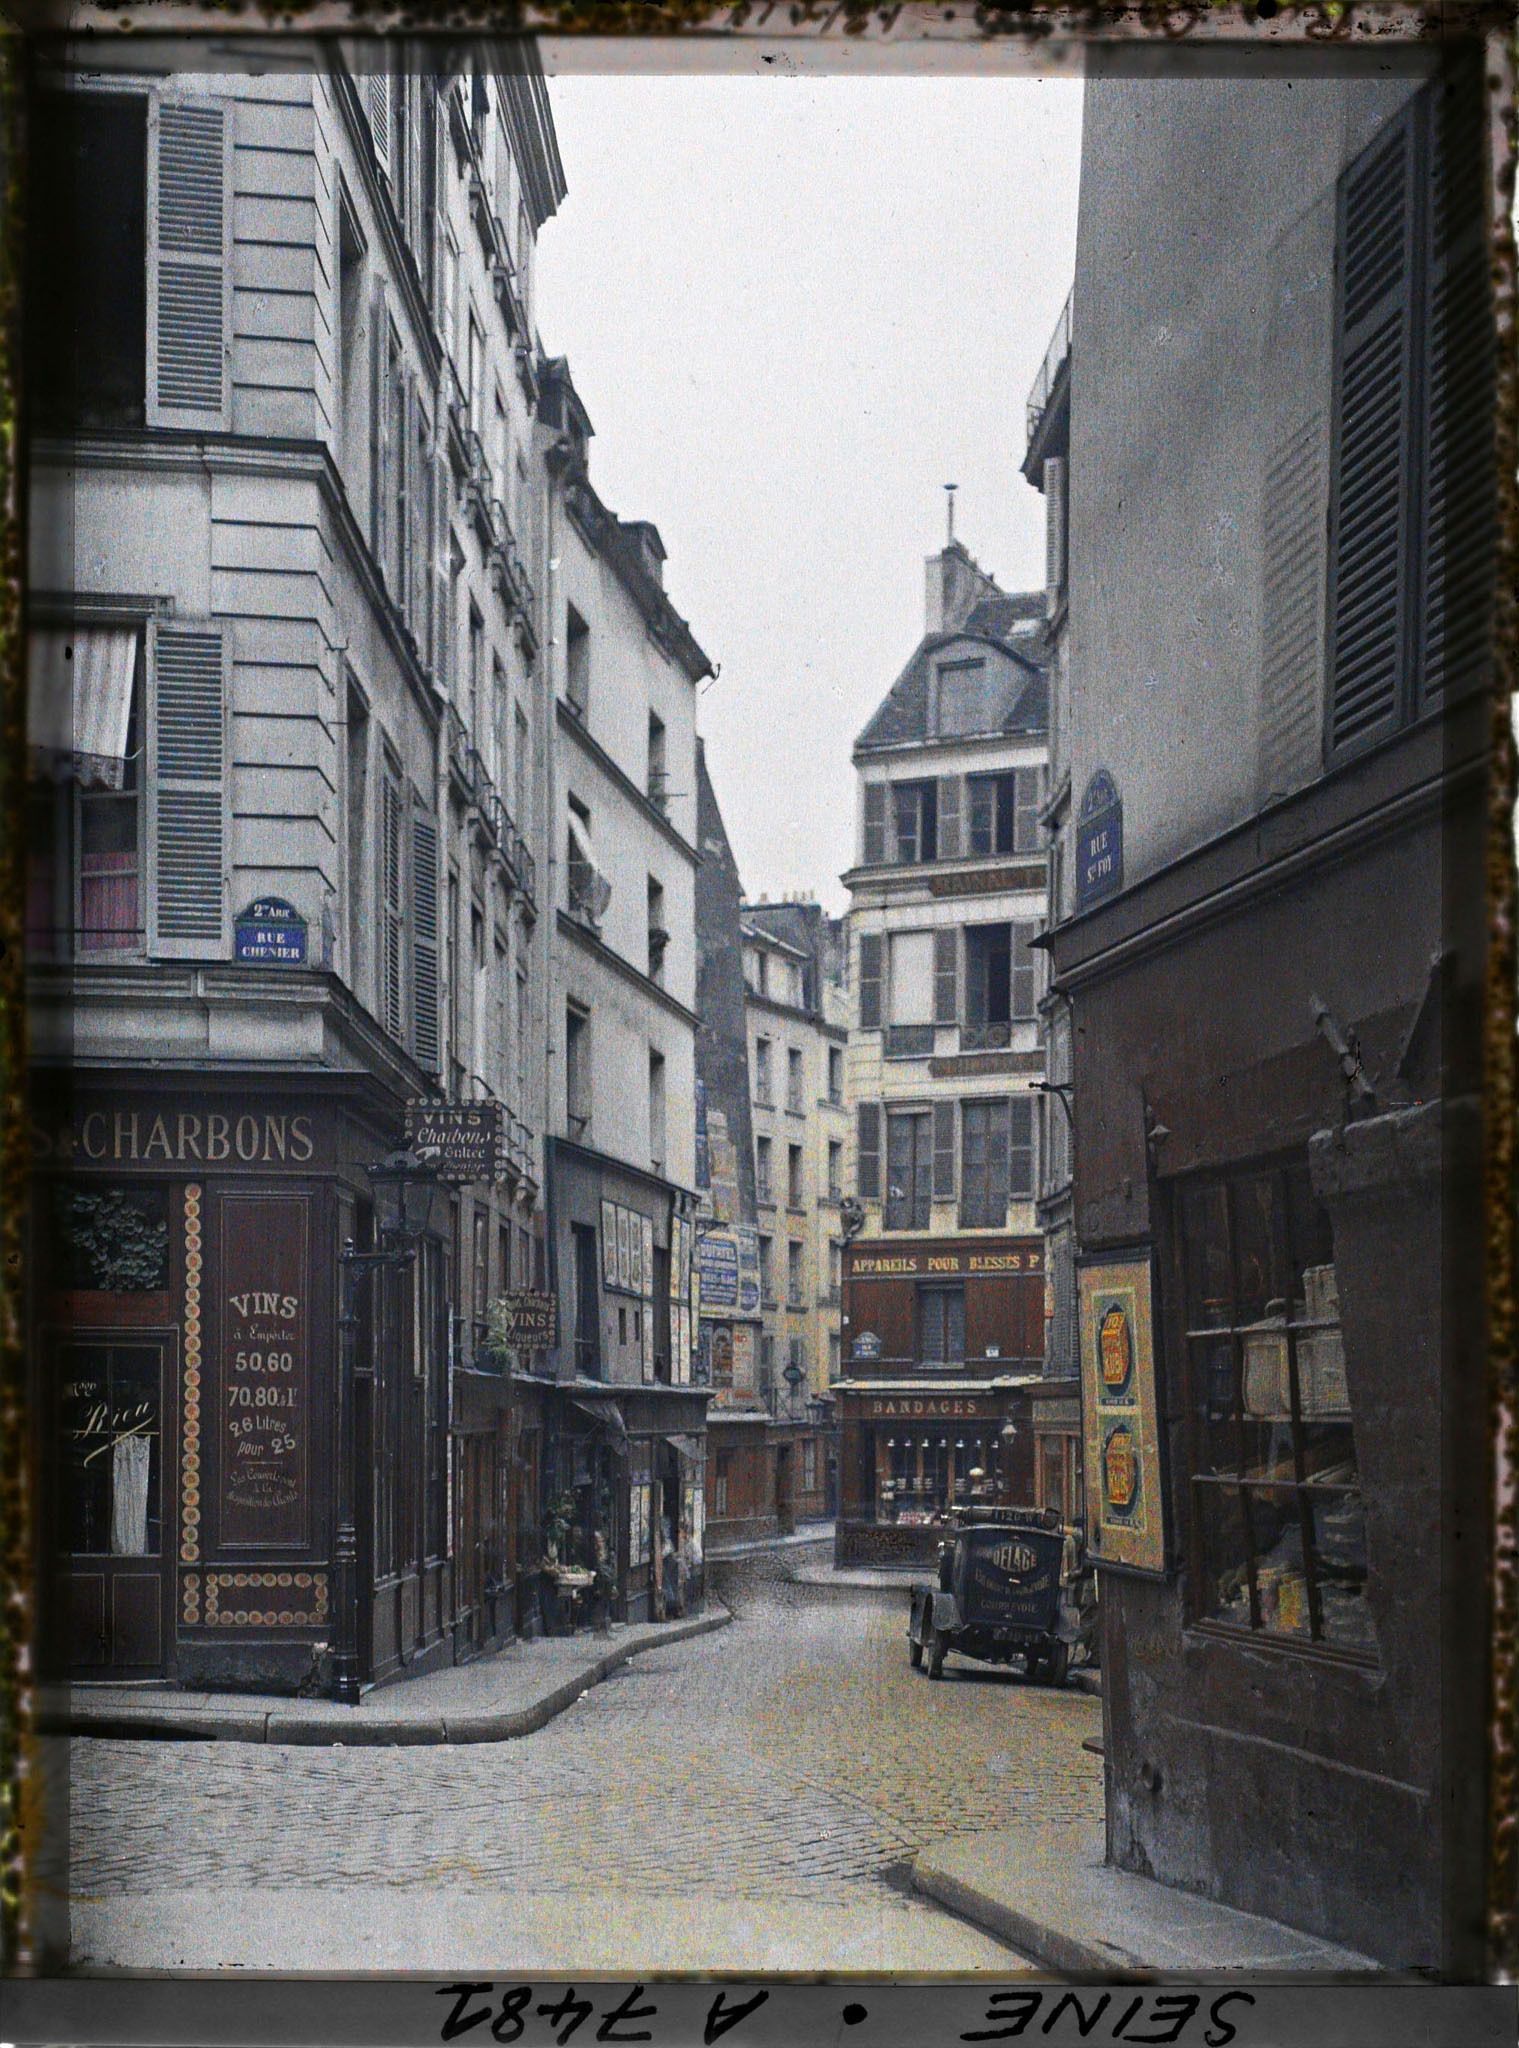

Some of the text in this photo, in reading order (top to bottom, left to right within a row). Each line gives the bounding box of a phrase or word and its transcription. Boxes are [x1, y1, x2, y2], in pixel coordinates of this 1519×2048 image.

[1091, 831, 1108, 857] RUE
[257, 931, 286, 944] RUE
[424, 1110, 481, 1126] VINS
[82, 1112, 314, 1162] CHARBONS
[852, 1257, 918, 1273] APPAREILS
[927, 1256, 960, 1271] POUR
[229, 1292, 298, 1319] VINS
[509, 1312, 547, 1328] VINS
[873, 1400, 978, 1415] BANDAGES
[229, 1416, 254, 1438] 26
[237, 1433, 296, 1457] pour 25
[993, 1545, 1038, 1573] DELAGE
